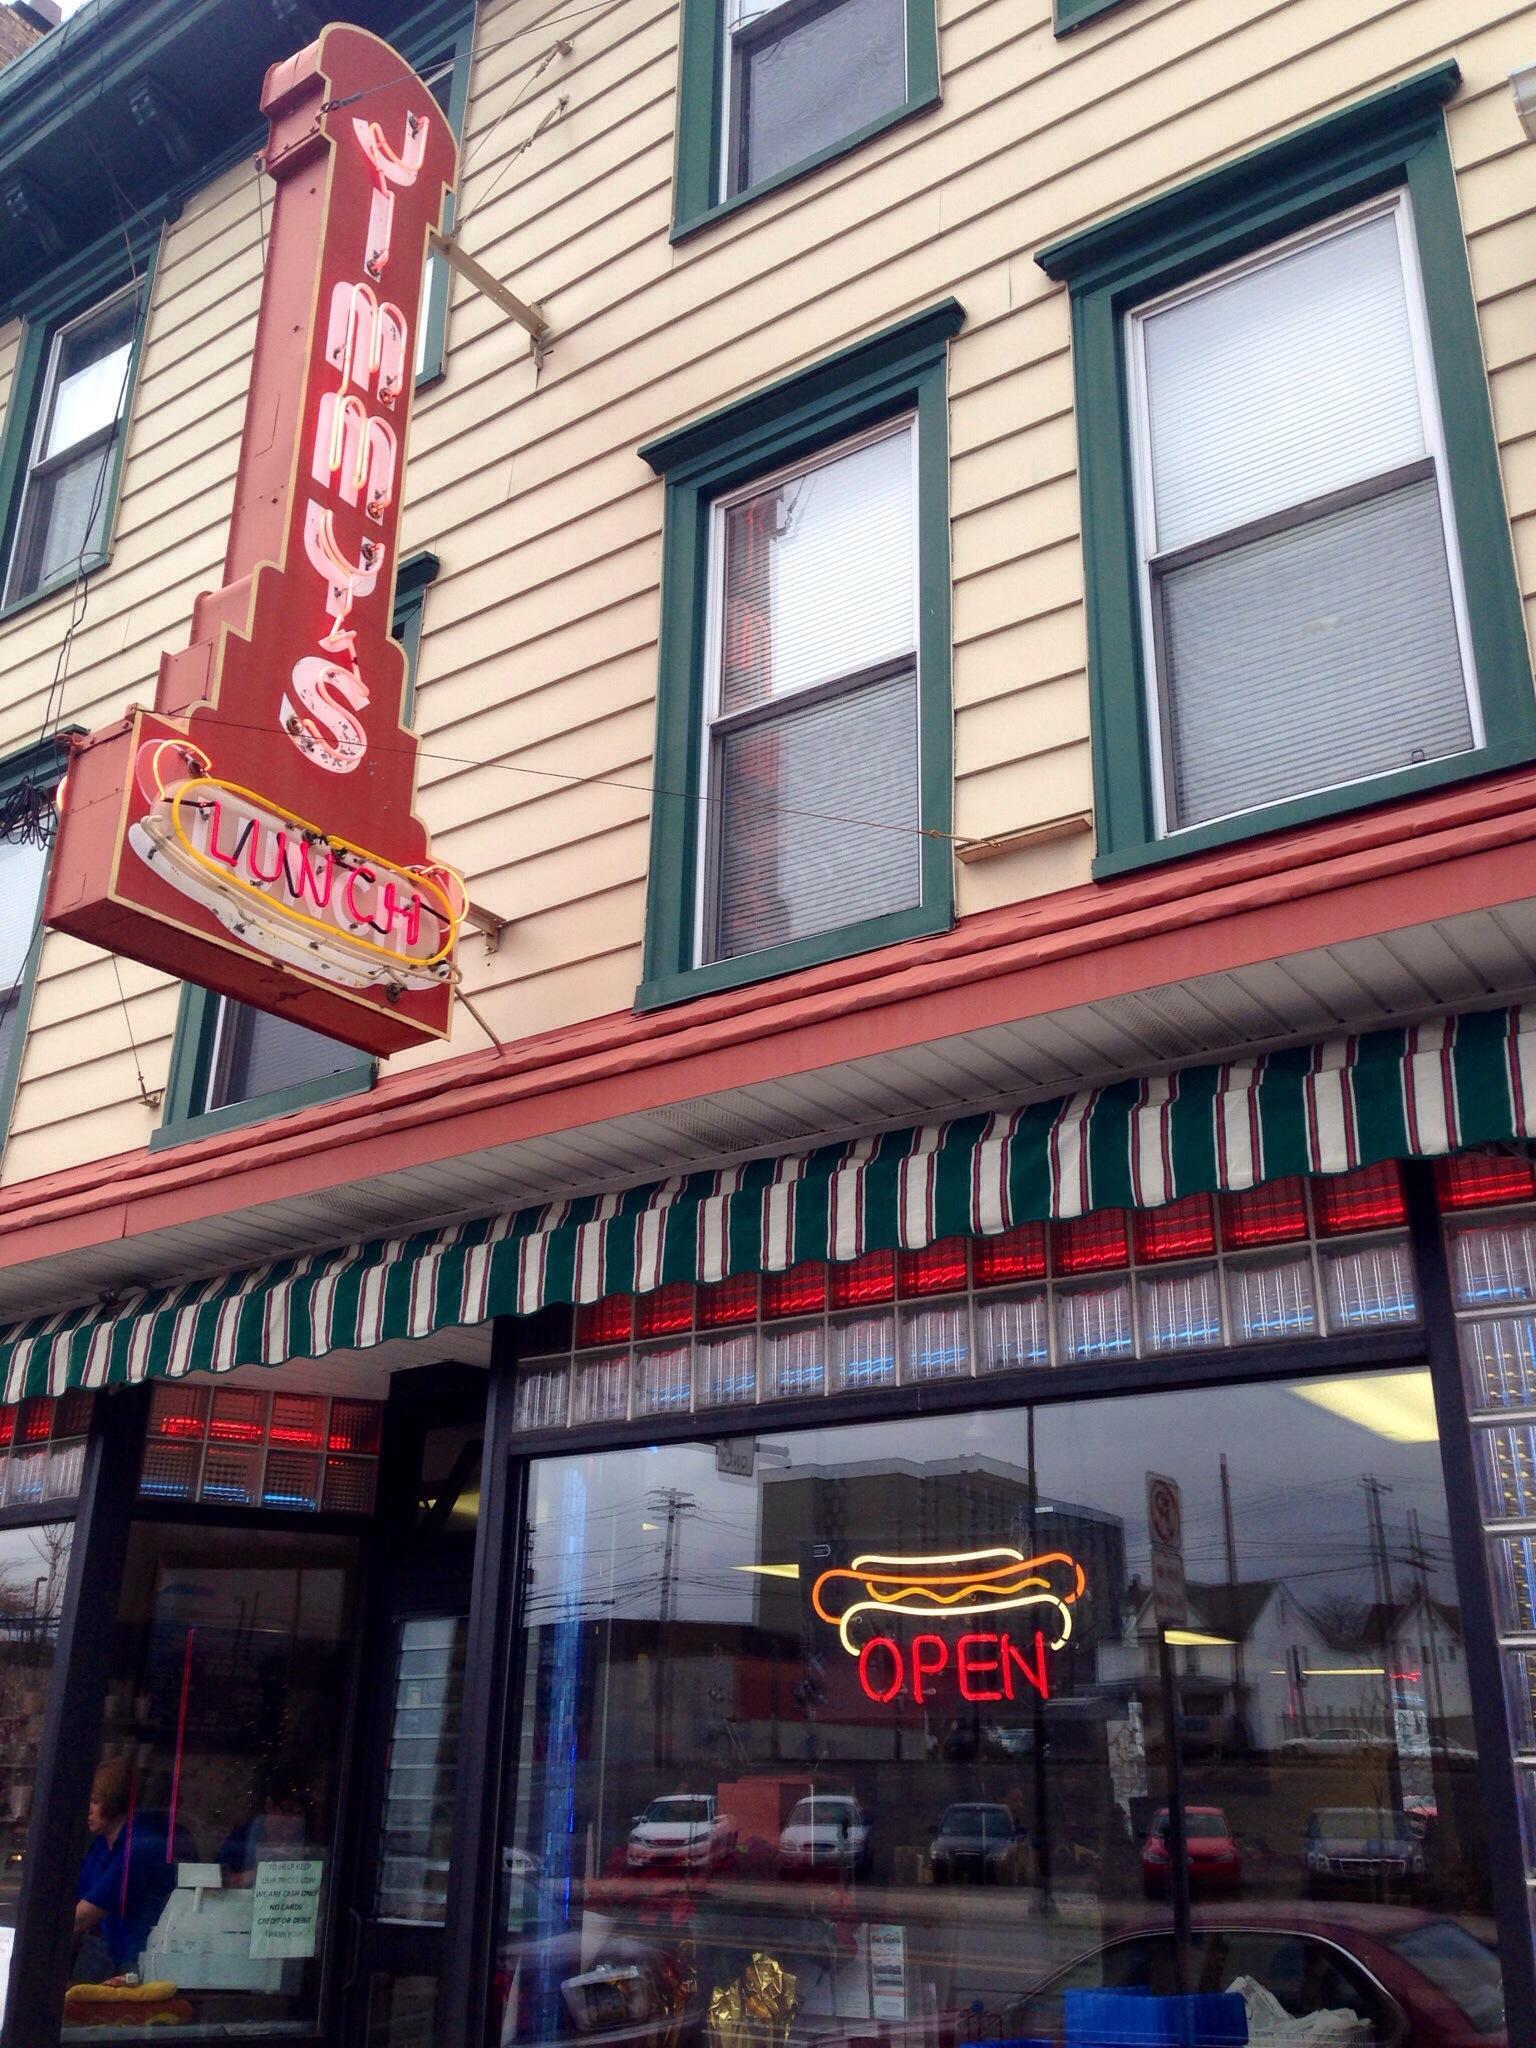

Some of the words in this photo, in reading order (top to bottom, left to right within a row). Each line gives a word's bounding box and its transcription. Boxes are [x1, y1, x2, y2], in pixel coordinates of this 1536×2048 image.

[191, 797, 420, 955] LUNCH
[858, 1631, 1049, 1704] OPEN
[278, 1863, 295, 1871] HELP
[282, 1890, 300, 1898] CASH
[269, 1903, 280, 1911] NO
[280, 1903, 303, 1911] CARDS
[257, 1917, 281, 1925] CREDIT
[292, 1917, 312, 1925] DEBIT
